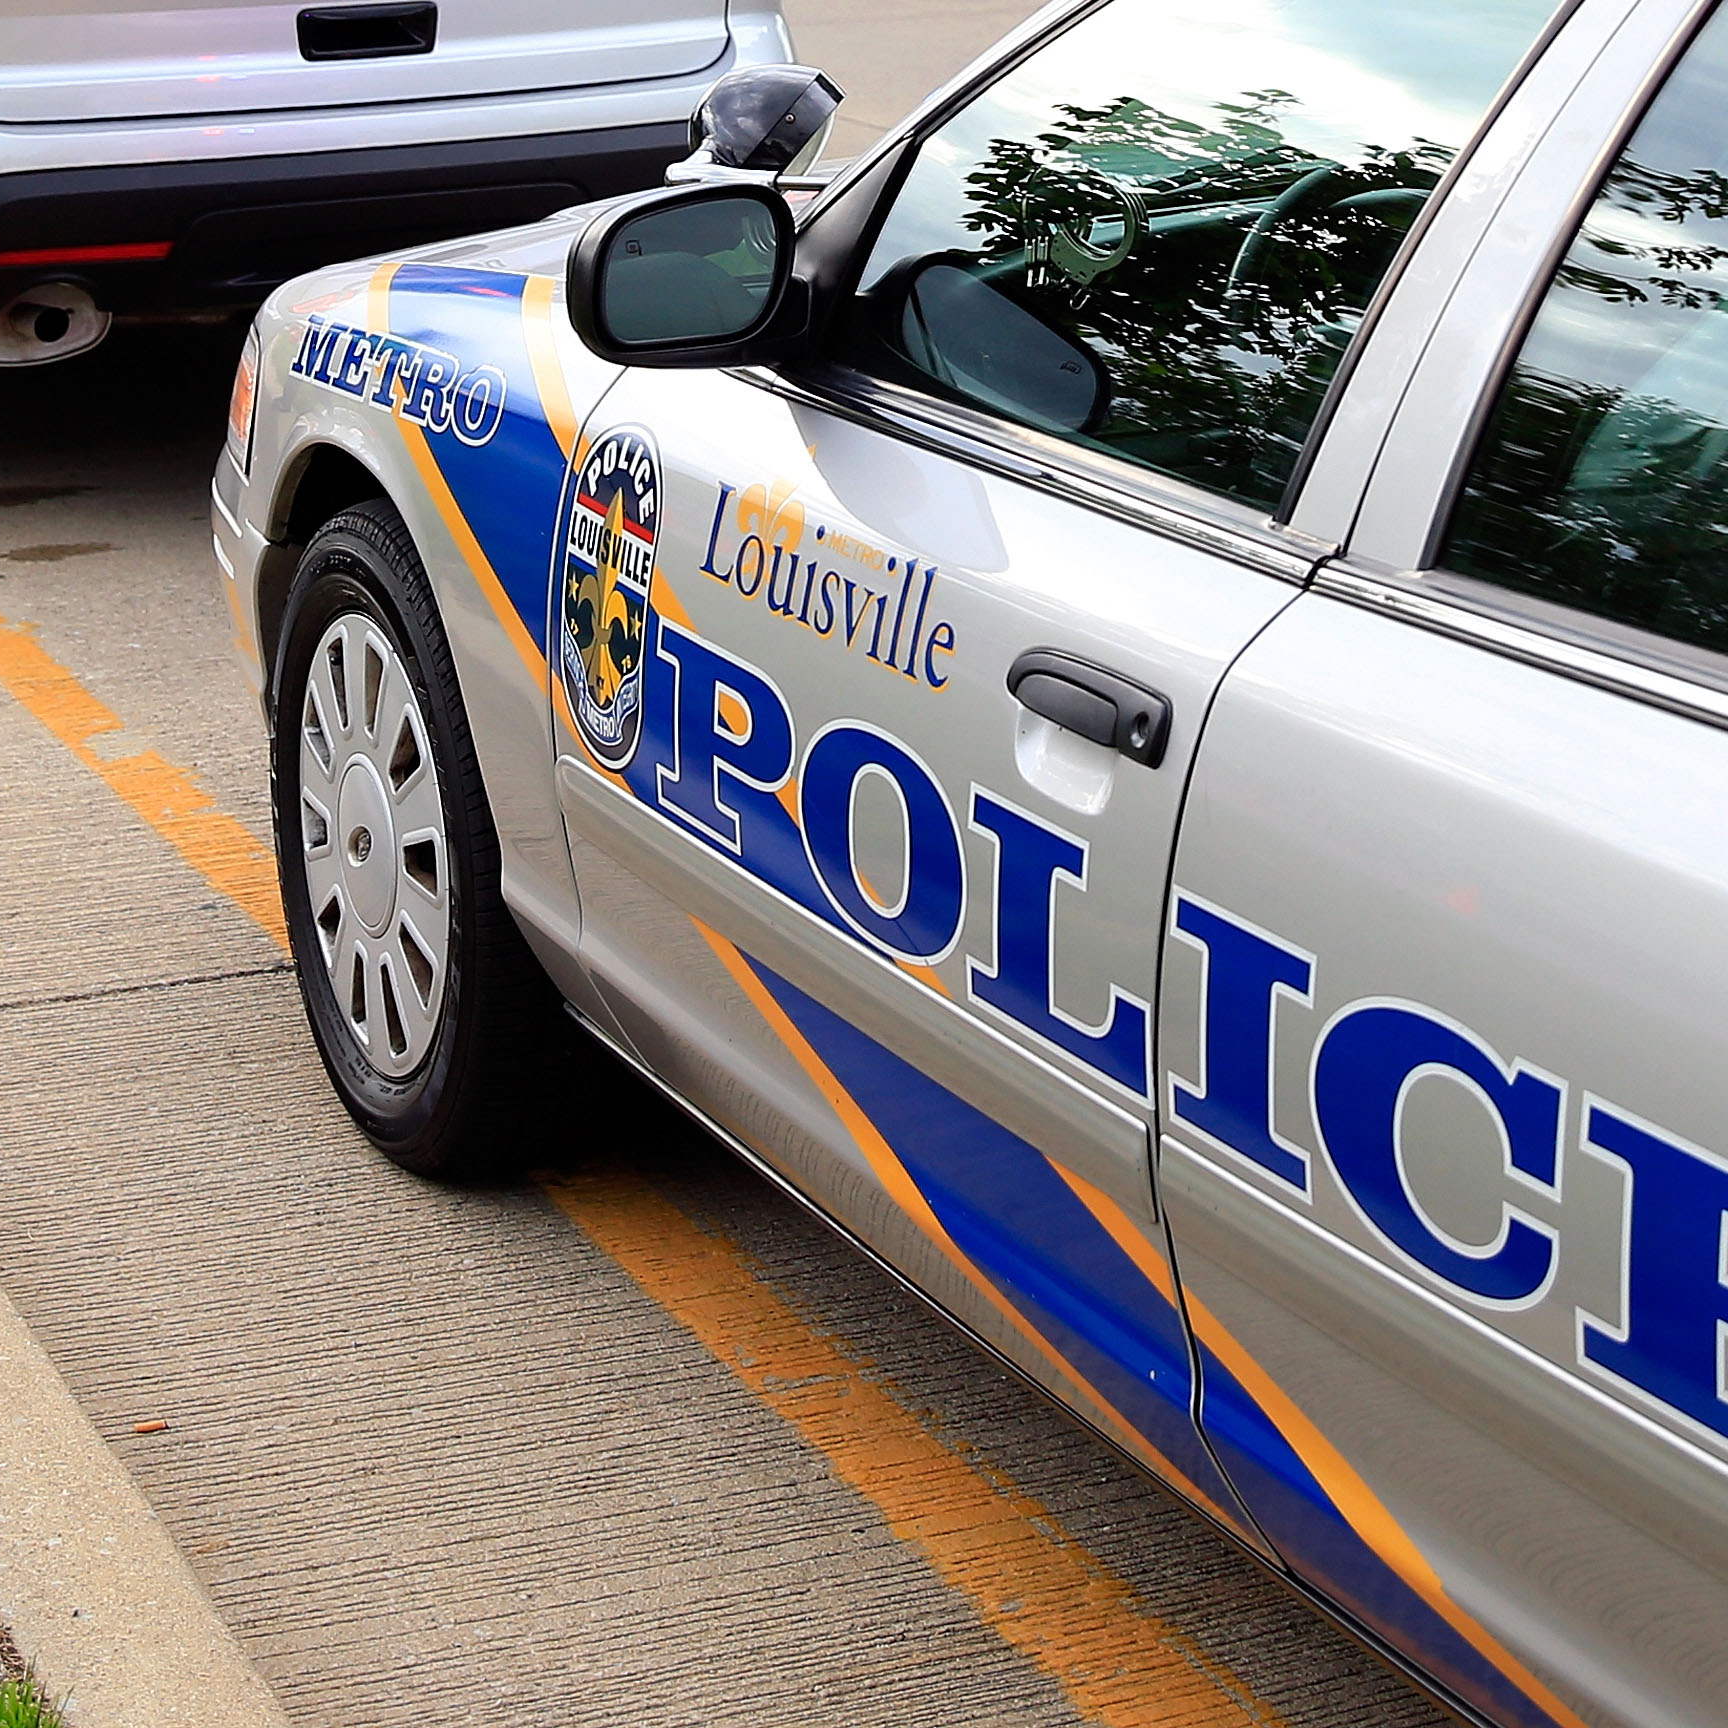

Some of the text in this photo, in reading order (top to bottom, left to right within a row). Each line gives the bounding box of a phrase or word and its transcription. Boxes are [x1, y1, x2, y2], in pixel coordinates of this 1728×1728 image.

[289, 314, 507, 446] METRO
[587, 436, 654, 524] POLICE
[570, 511, 651, 587] LOUISVILLE
[699, 480, 956, 693] Louisville
[828, 529, 883, 571] METRO
